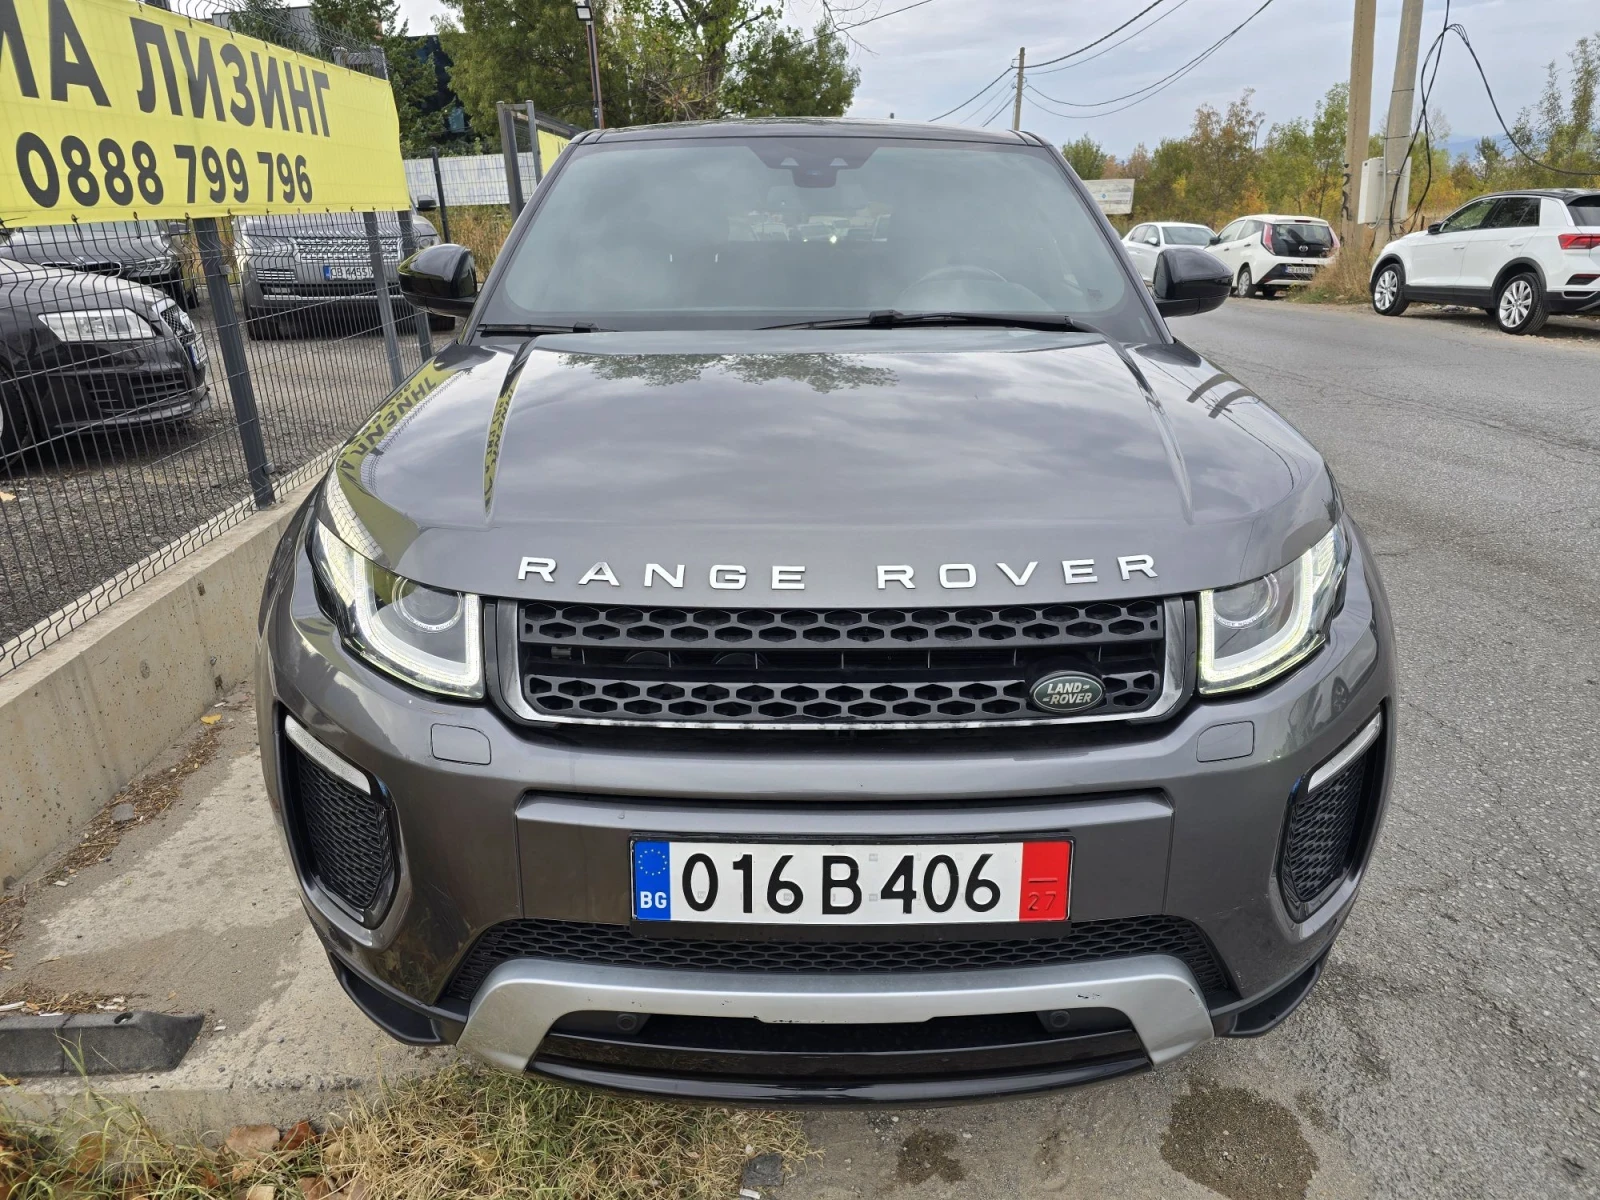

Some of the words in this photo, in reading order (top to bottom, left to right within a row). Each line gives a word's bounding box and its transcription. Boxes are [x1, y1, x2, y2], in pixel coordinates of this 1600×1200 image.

[130, 17, 330, 137] ЛИЗИНГ
[16, 132, 164, 208] 0888
[175, 145, 249, 203] 799
[257, 152, 312, 203] 796
[517, 556, 805, 590] RANGE
[876, 553, 1159, 589] ROVER
[1050, 692, 1092, 705] ROVER
[640, 891, 667, 909] BG
[1028, 891, 1057, 911] 27
